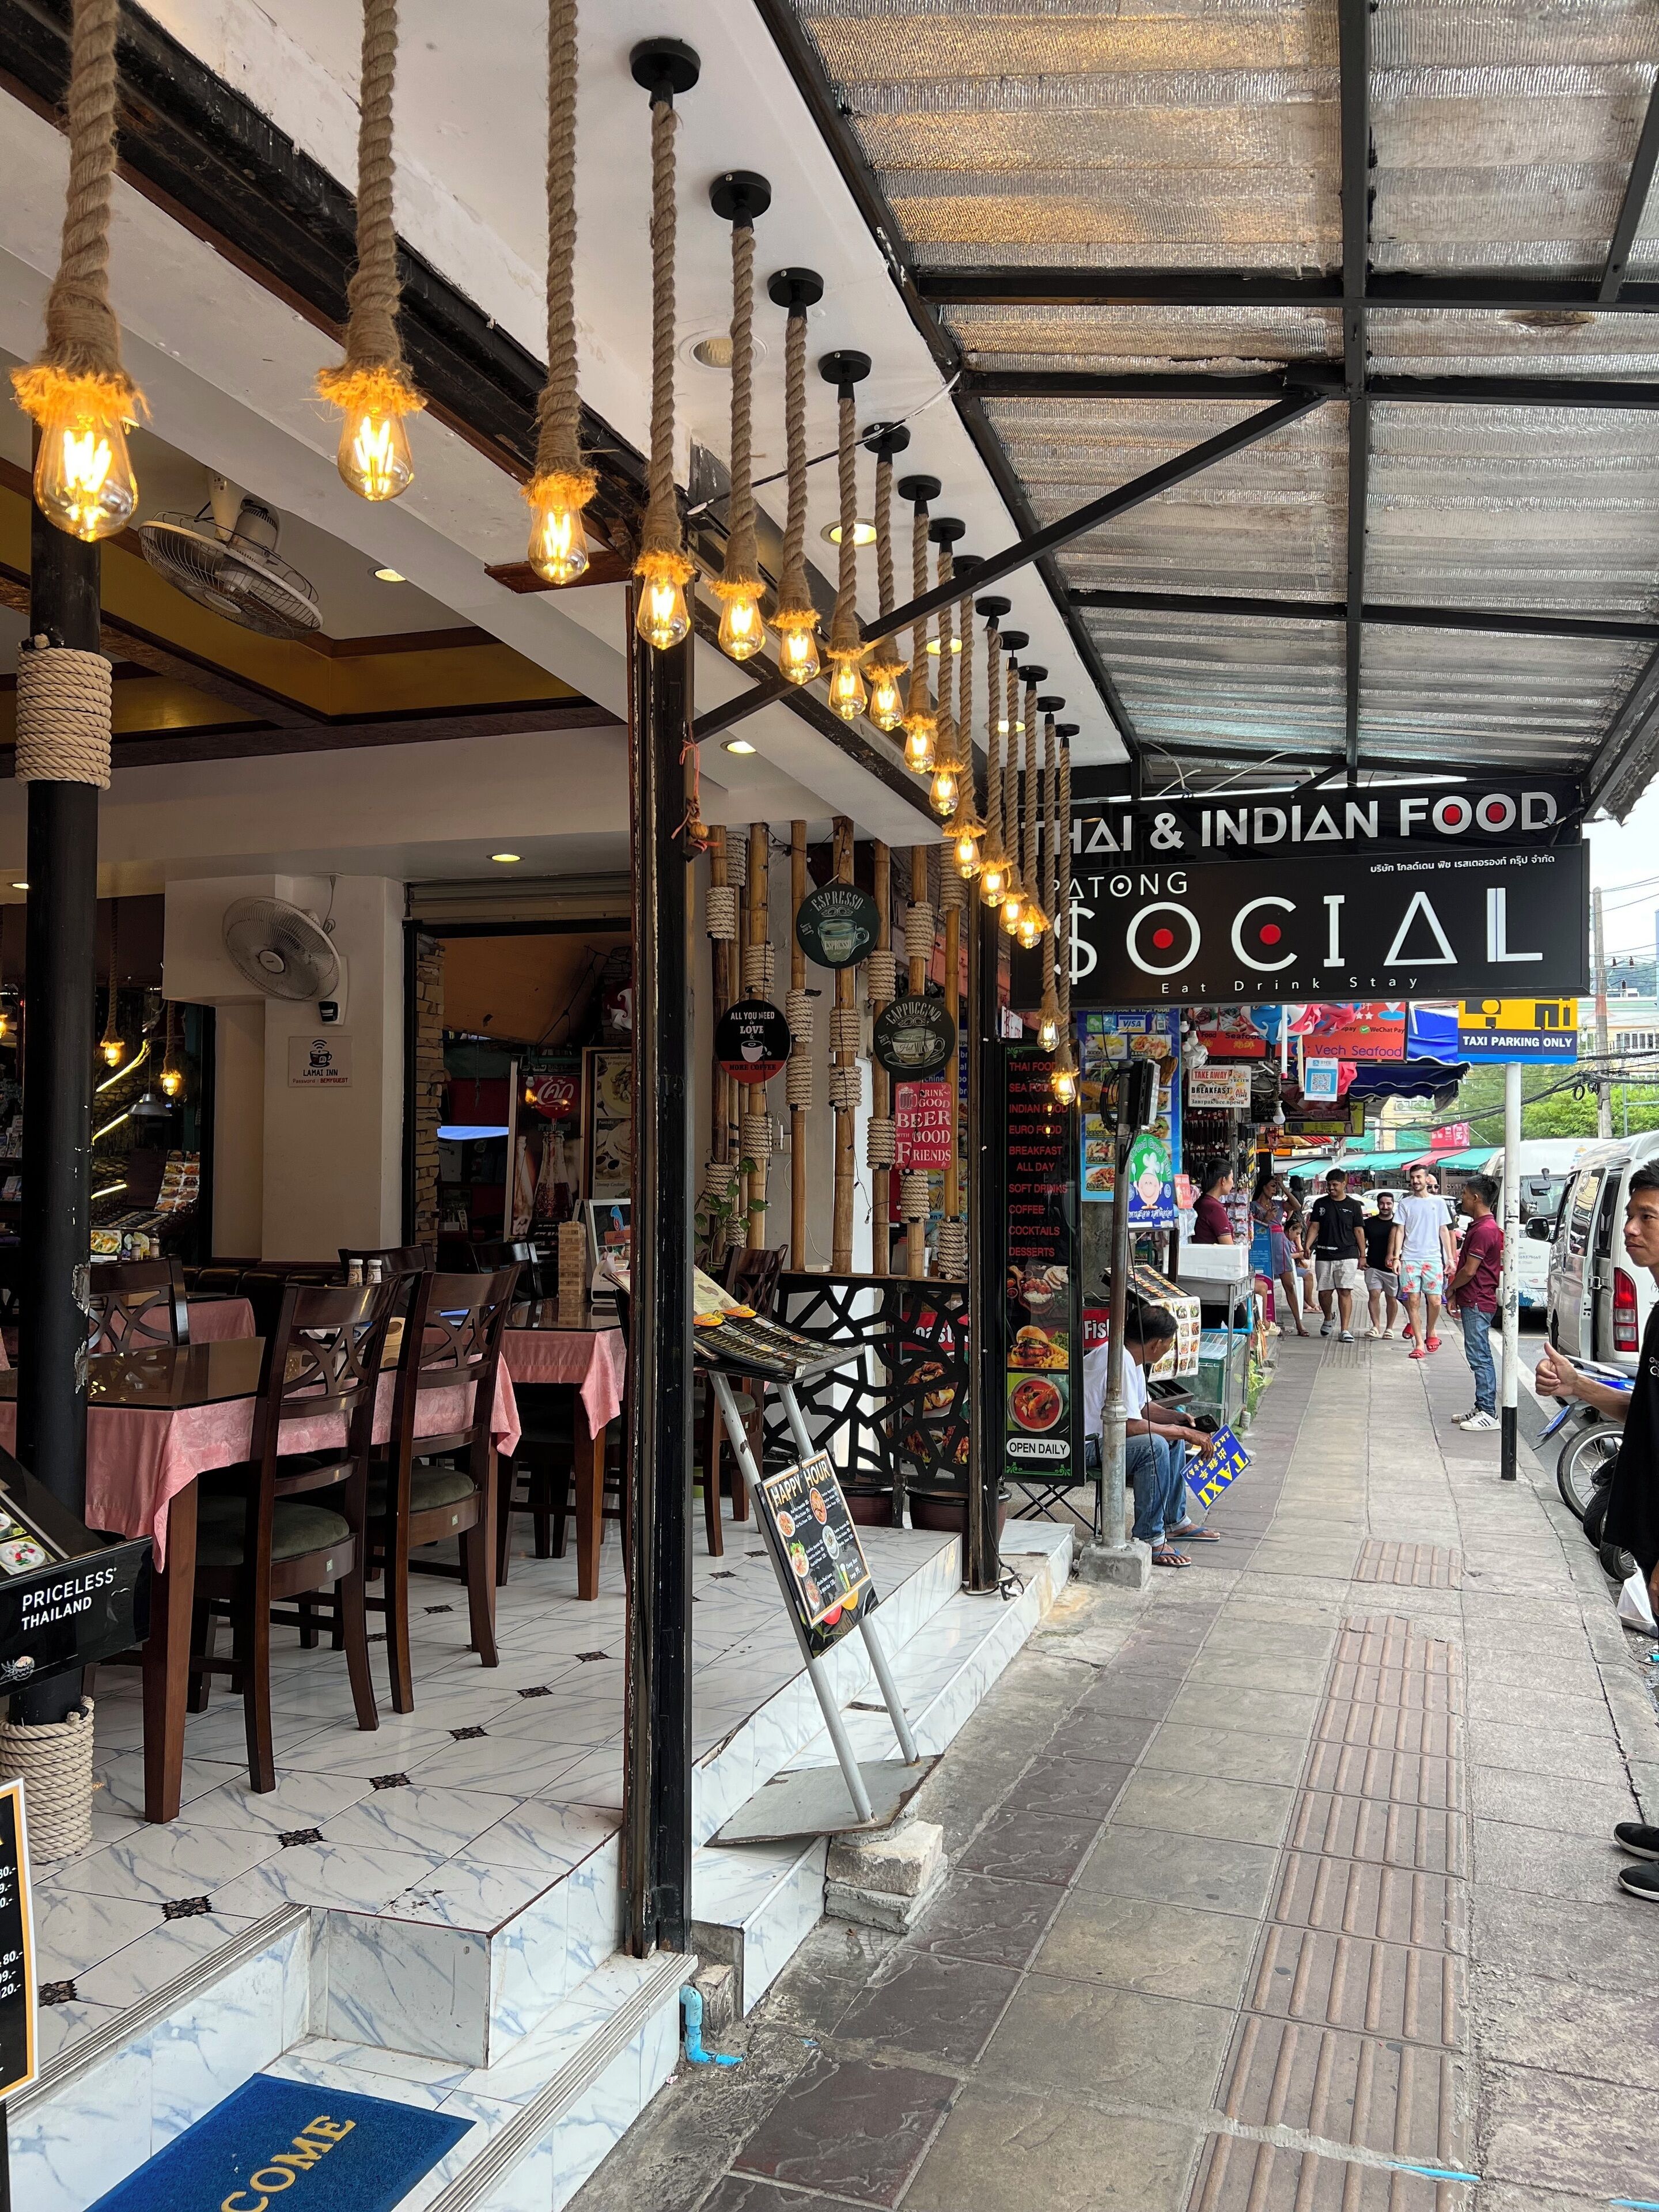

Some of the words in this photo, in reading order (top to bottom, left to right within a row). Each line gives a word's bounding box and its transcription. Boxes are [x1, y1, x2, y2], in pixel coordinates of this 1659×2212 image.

[1150, 812, 1184, 850] &
[1201, 801, 1379, 847] INDIAN
[1400, 791, 1558, 836] FOOD
[1370, 863, 1394, 872] บริษัท
[1531, 854, 1555, 863] จำกัด
[810, 891, 864, 912] ESPRESSO
[824, 940, 851, 950] ESPRESSO
[1161, 982, 1206, 994] Eat
[1234, 977, 1320, 992] Drink
[1349, 975, 1419, 990] Stay
[730, 1012, 742, 1020] ALL
[744, 1012, 757, 1020] YOU
[759, 1012, 775, 1020] NEED
[885, 1001, 941, 1025] CAPPUCCINO
[740, 1025, 764, 1034] LOVE
[1463, 1036, 1488, 1046] TAXI
[1491, 1036, 1539, 1047] PARKING
[1543, 1037, 1573, 1048] ONLY
[1315, 1044, 1346, 1055] Vech
[1351, 1046, 1402, 1056] Seafood
[1009, 1062, 1030, 1071] THAI
[1194, 1071, 1209, 1079] TAKE
[1210, 1071, 1227, 1079] AWAY
[1009, 1083, 1027, 1092] SEA
[1029, 1082, 1054, 1092] FOO
[919, 1098, 950, 1108] GOOD
[1009, 1104, 1040, 1113] INDIAN
[896, 1111, 951, 1128] BEER
[1009, 1125, 1034, 1134] EURO
[912, 1130, 950, 1143] GOOD
[896, 1142, 951, 1164] FRIENDS
[1009, 1146, 1062, 1155] BREAKFAST
[1017, 1162, 1033, 1171] ALL
[1036, 1162, 1055, 1171] DAY
[1009, 1184, 1032, 1193] SOFT
[1034, 1184, 1067, 1193] DRINKS
[1009, 1205, 1044, 1214] COFFEE
[1009, 1226, 1060, 1236] COCKTAILS
[1009, 1247, 1055, 1256] DESSERTS
[1009, 1442, 1036, 1453] OPEN
[1039, 1444, 1067, 1455] DAILY
[770, 1477, 804, 1507] HAPPY
[805, 1460, 831, 1490] HOUR
[1198, 1451, 1249, 1508] TAXI
[22, 1567, 116, 1612] PRICELESS
[21, 1596, 92, 1630] THAILAND
[0, 1883, 13, 1894] 9.-
[0, 1897, 14, 1908] 0.-
[3, 1950, 24, 1965] 80.-
[0, 1983, 22, 1999] 20.-
[221, 2115, 357, 2212] COME
